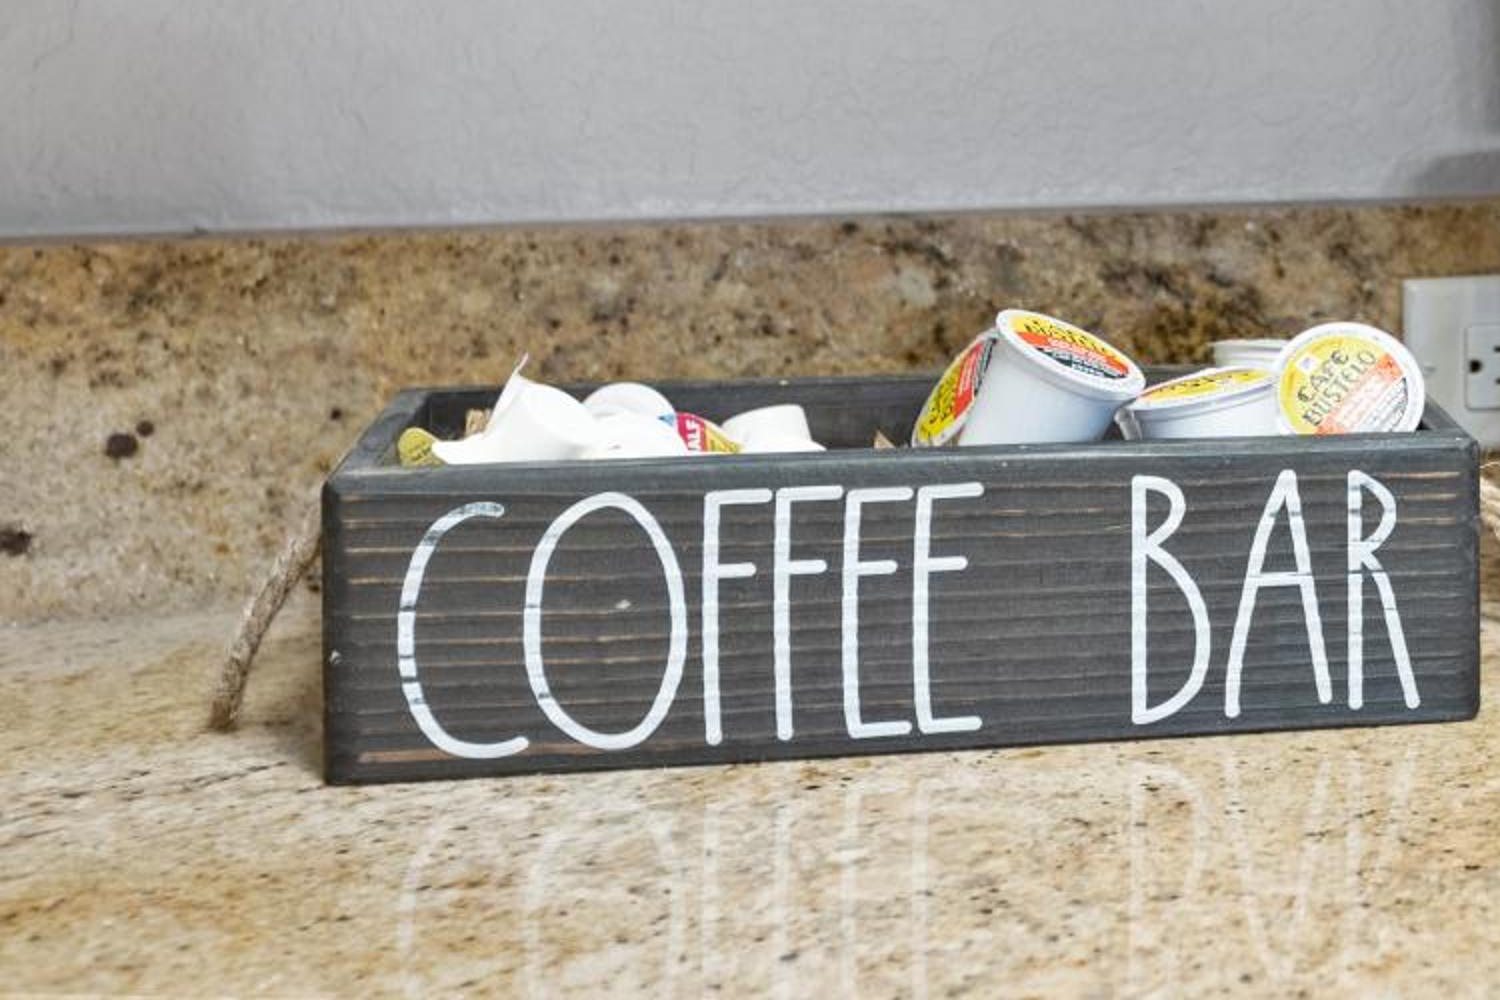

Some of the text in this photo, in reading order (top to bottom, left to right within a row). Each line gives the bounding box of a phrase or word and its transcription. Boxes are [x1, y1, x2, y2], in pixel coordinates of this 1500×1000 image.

[1303, 351, 1377, 426] BUSTELO
[685, 419, 702, 451] ALF
[398, 469, 1421, 760] COFFEE BAR
